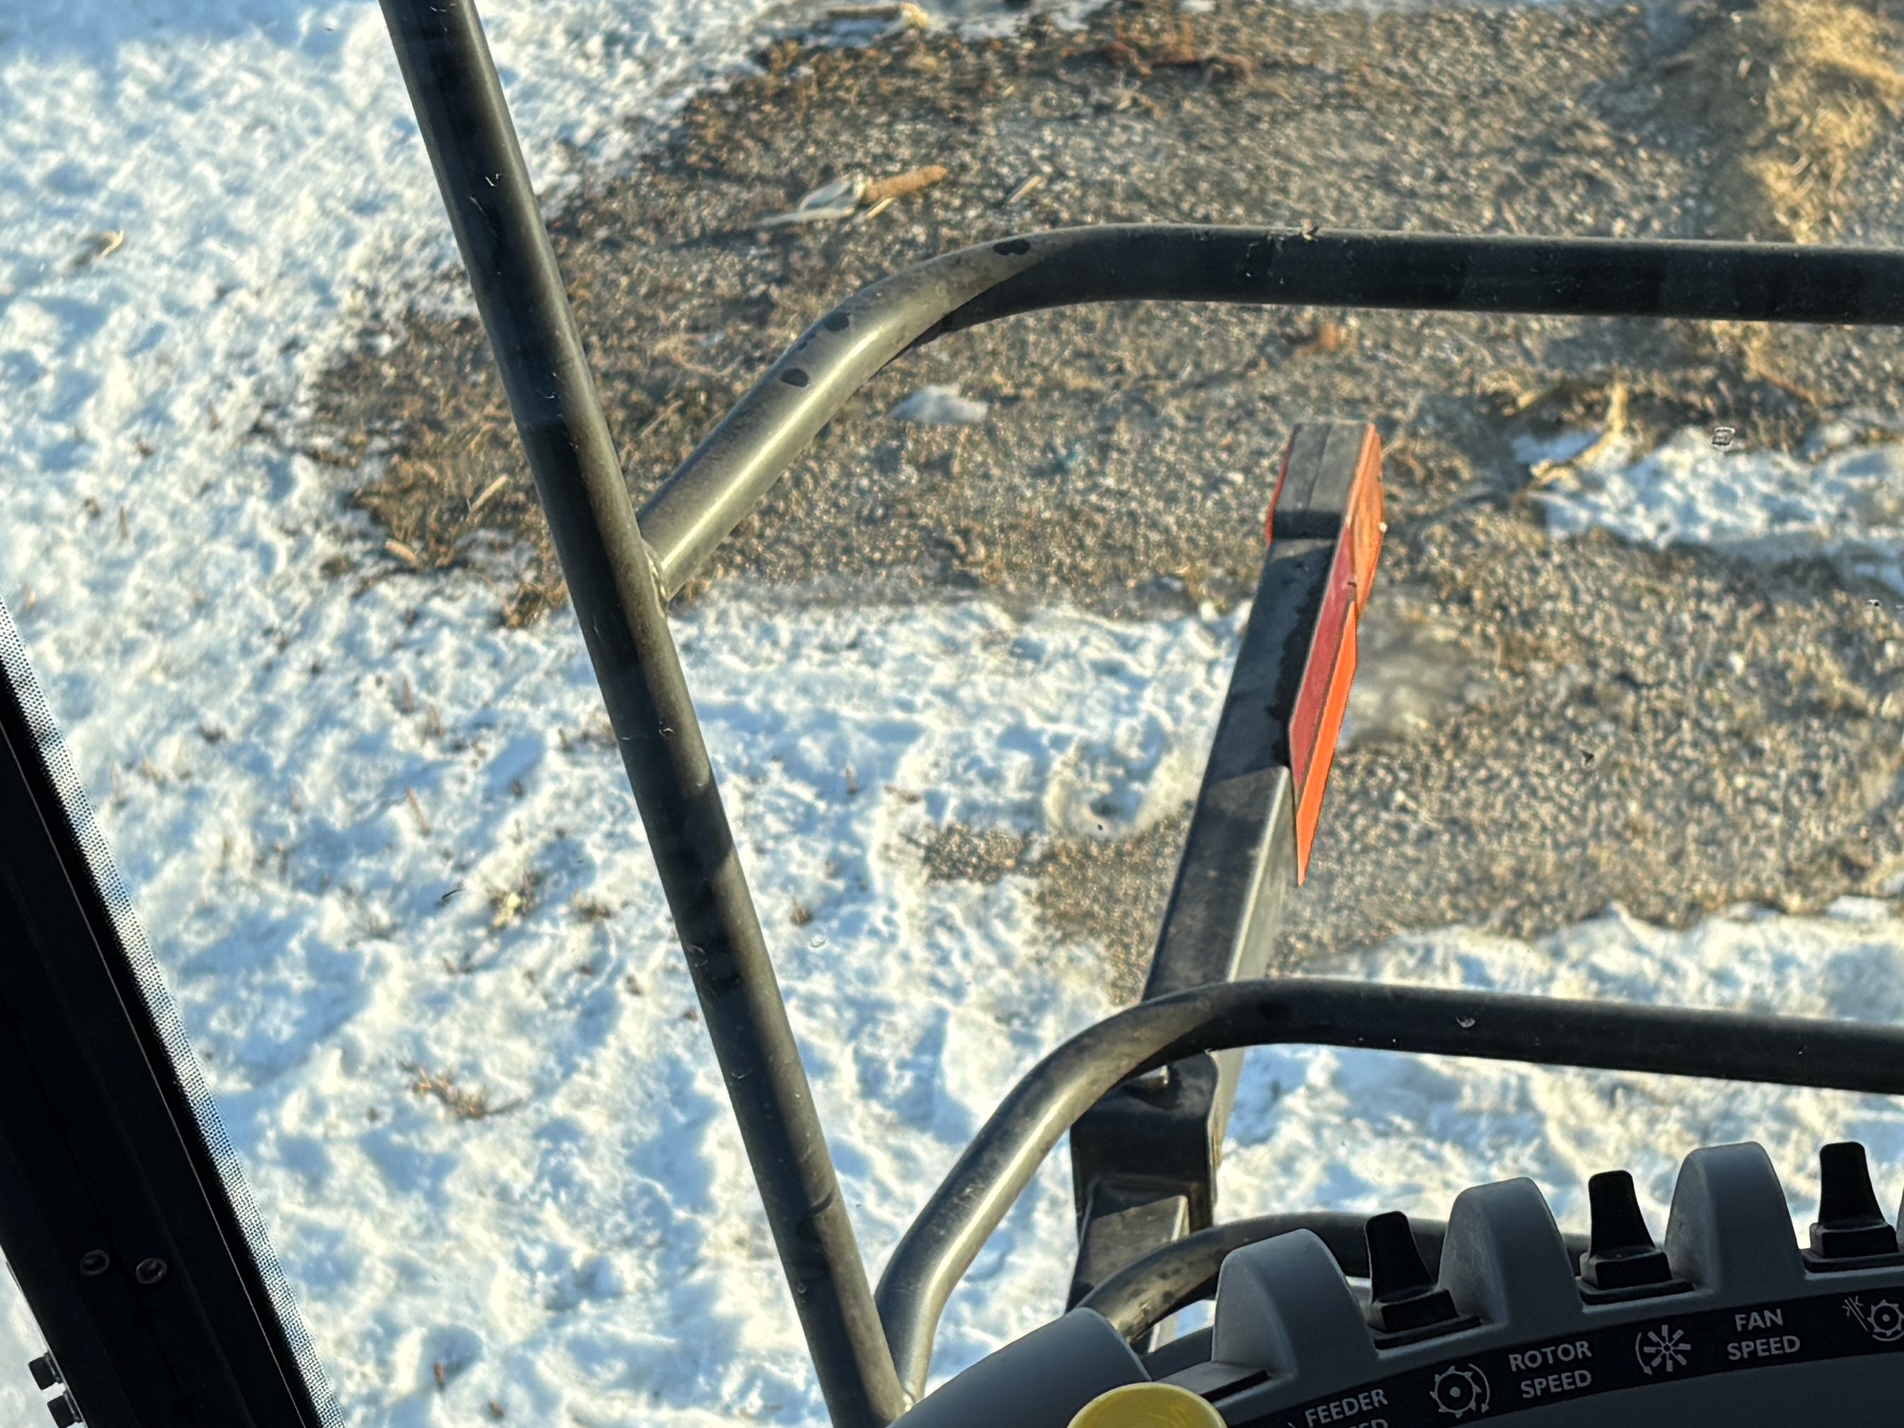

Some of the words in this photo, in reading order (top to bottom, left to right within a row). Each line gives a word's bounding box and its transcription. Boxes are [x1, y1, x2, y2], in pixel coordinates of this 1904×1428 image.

[1733, 1308, 1785, 1332] FAN
[1508, 1340, 1593, 1373] ROTOR
[1726, 1334, 1801, 1361] SPEED
[1520, 1369, 1593, 1399] SPEED
[1304, 1388, 1389, 1428] FEEDER
